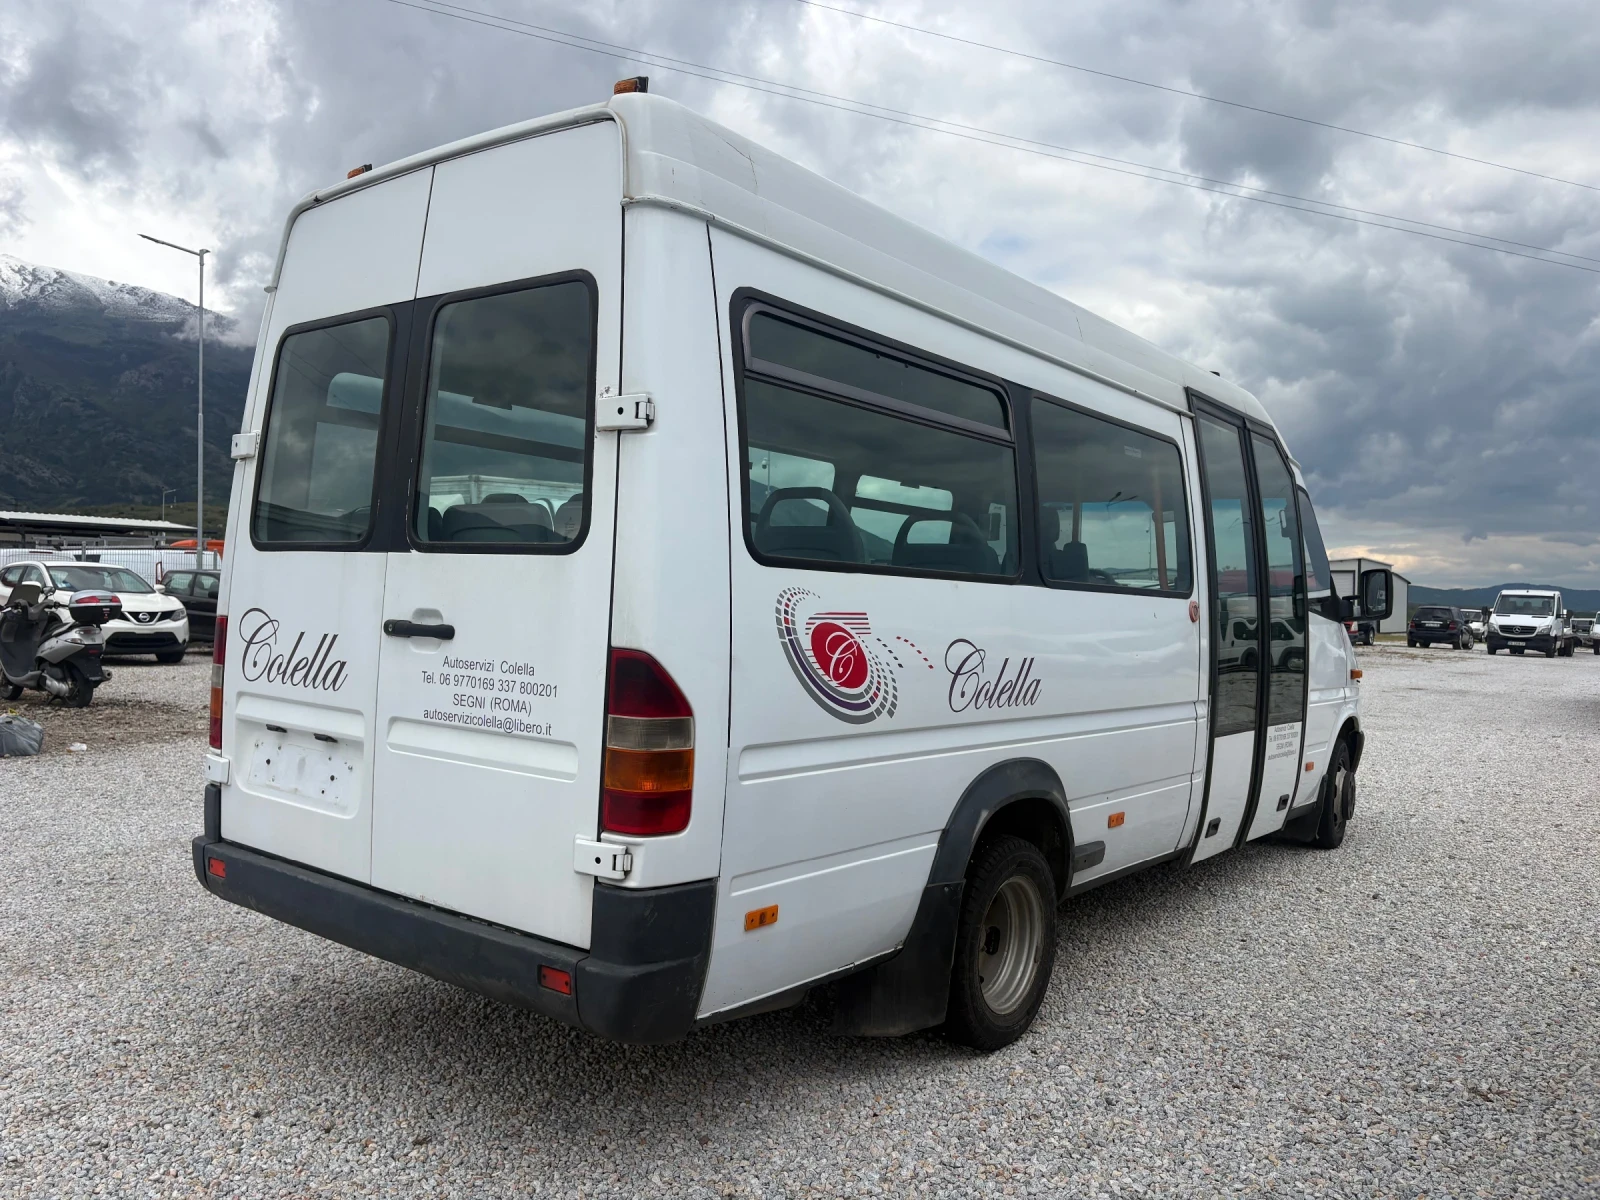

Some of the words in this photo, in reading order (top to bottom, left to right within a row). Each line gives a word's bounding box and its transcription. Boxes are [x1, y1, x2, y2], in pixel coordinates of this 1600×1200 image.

[239, 607, 348, 692] Colella
[442, 655, 495, 673] Autoservizi
[500, 660, 535, 677] Colella
[944, 638, 1042, 713] Colella
[421, 670, 437, 685] Tel.
[439, 672, 451, 686] 06
[453, 674, 495, 691] 9770169
[497, 679, 517, 693] 337
[519, 681, 558, 698] 800201
[452, 693, 486, 709] SEGNI
[490, 697, 532, 717] (ROMA)
[423, 708, 552, 736] autoservizicolella@libero.it
